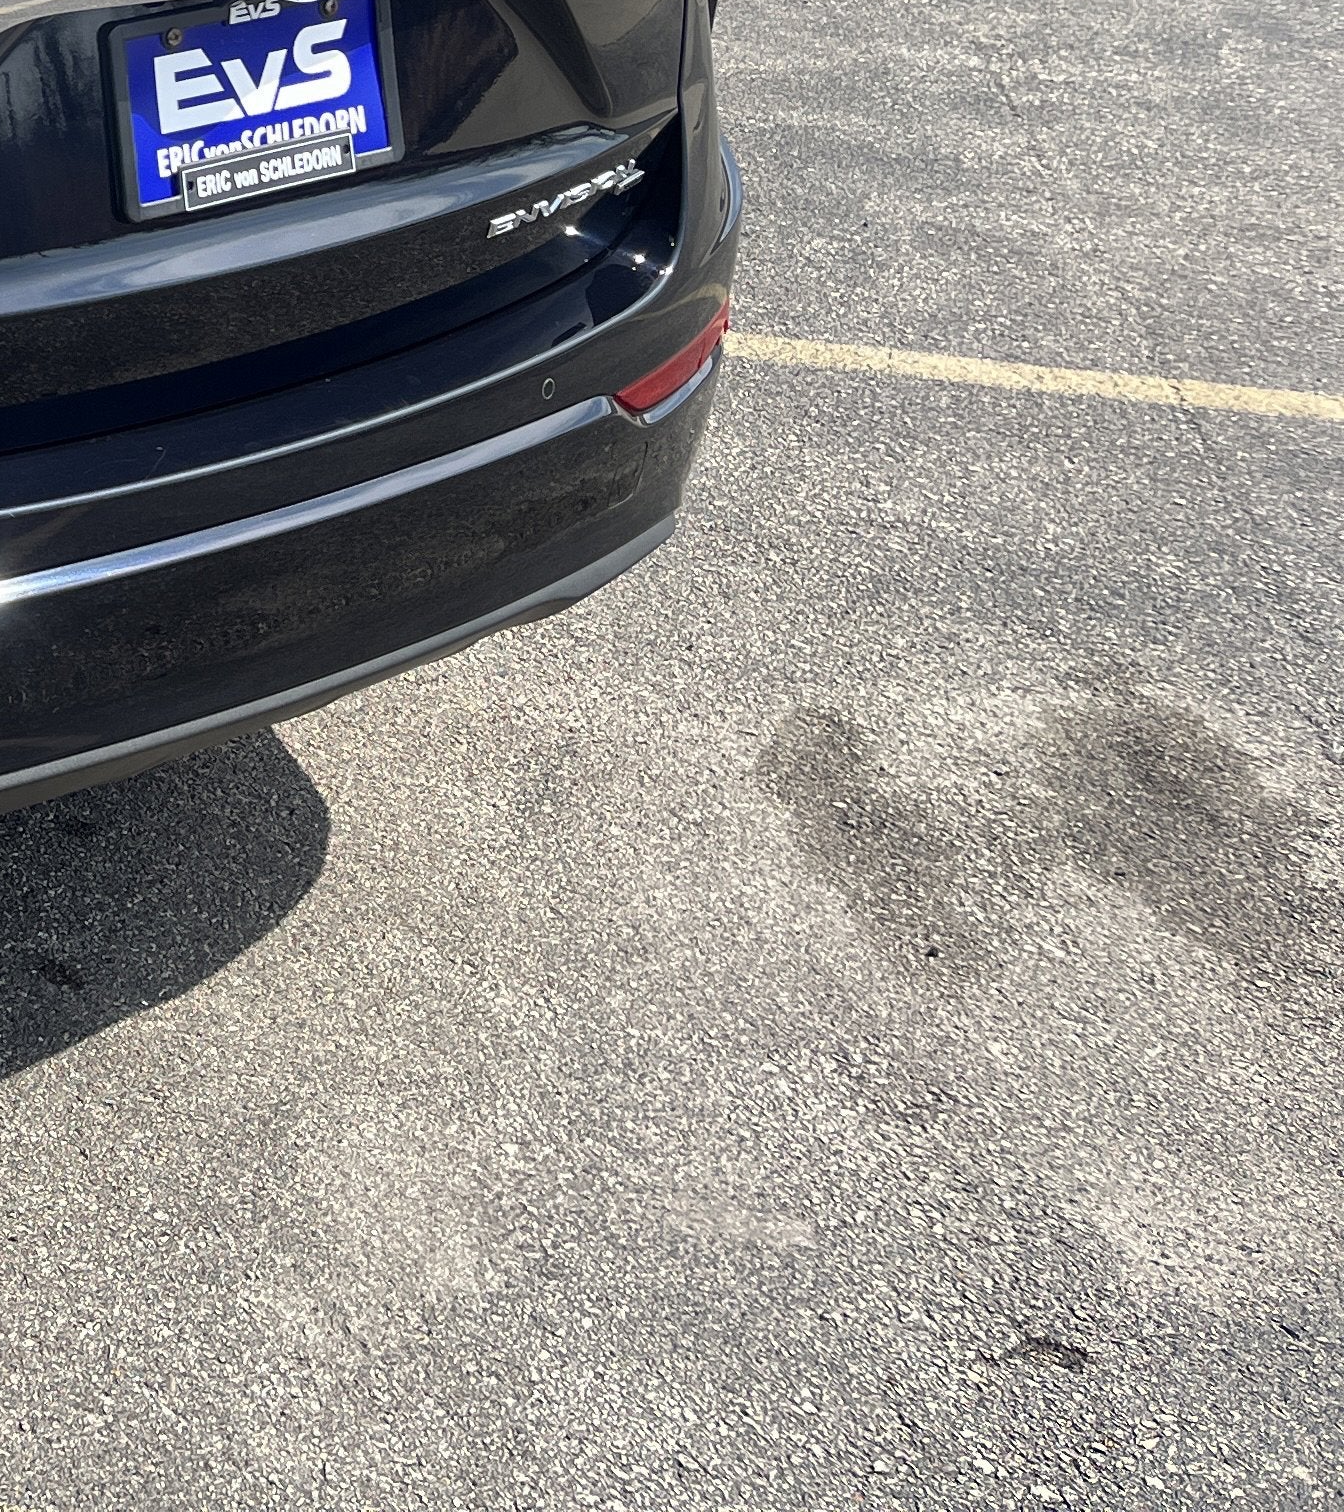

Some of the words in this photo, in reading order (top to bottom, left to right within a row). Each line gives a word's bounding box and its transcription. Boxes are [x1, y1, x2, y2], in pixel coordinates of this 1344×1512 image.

[196, 170, 232, 198] ERIC
[234, 168, 259, 189] von
[259, 144, 342, 183] SCHLEDORN
